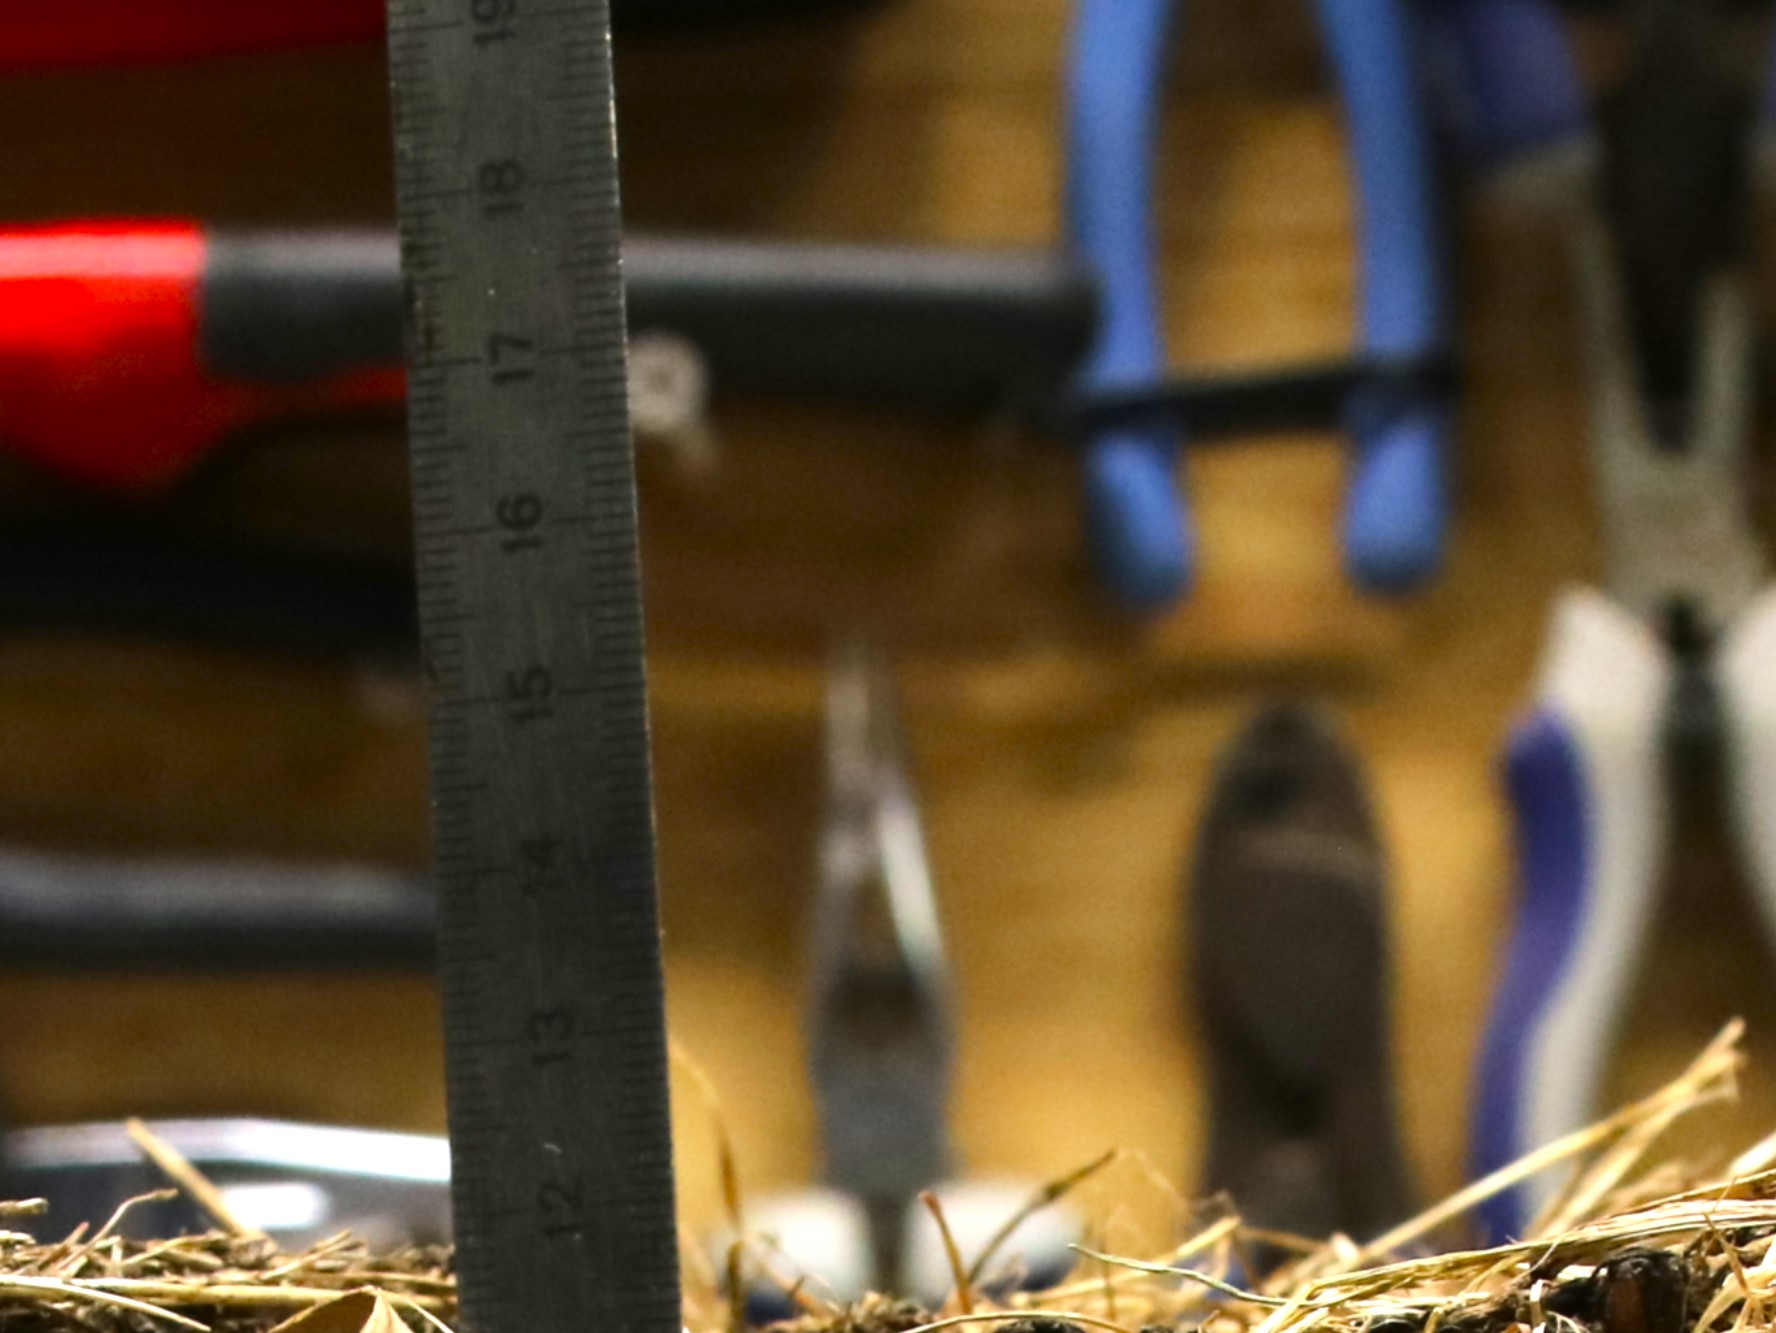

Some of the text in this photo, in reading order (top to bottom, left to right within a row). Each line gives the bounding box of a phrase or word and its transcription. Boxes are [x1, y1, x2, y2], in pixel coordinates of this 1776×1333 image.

[470, 0, 515, 45] 19
[478, 159, 524, 219] 18
[487, 332, 534, 386] 17
[496, 493, 545, 553] 16
[506, 664, 554, 725] 15
[525, 1006, 574, 1066] 13
[537, 1178, 583, 1238] 12
